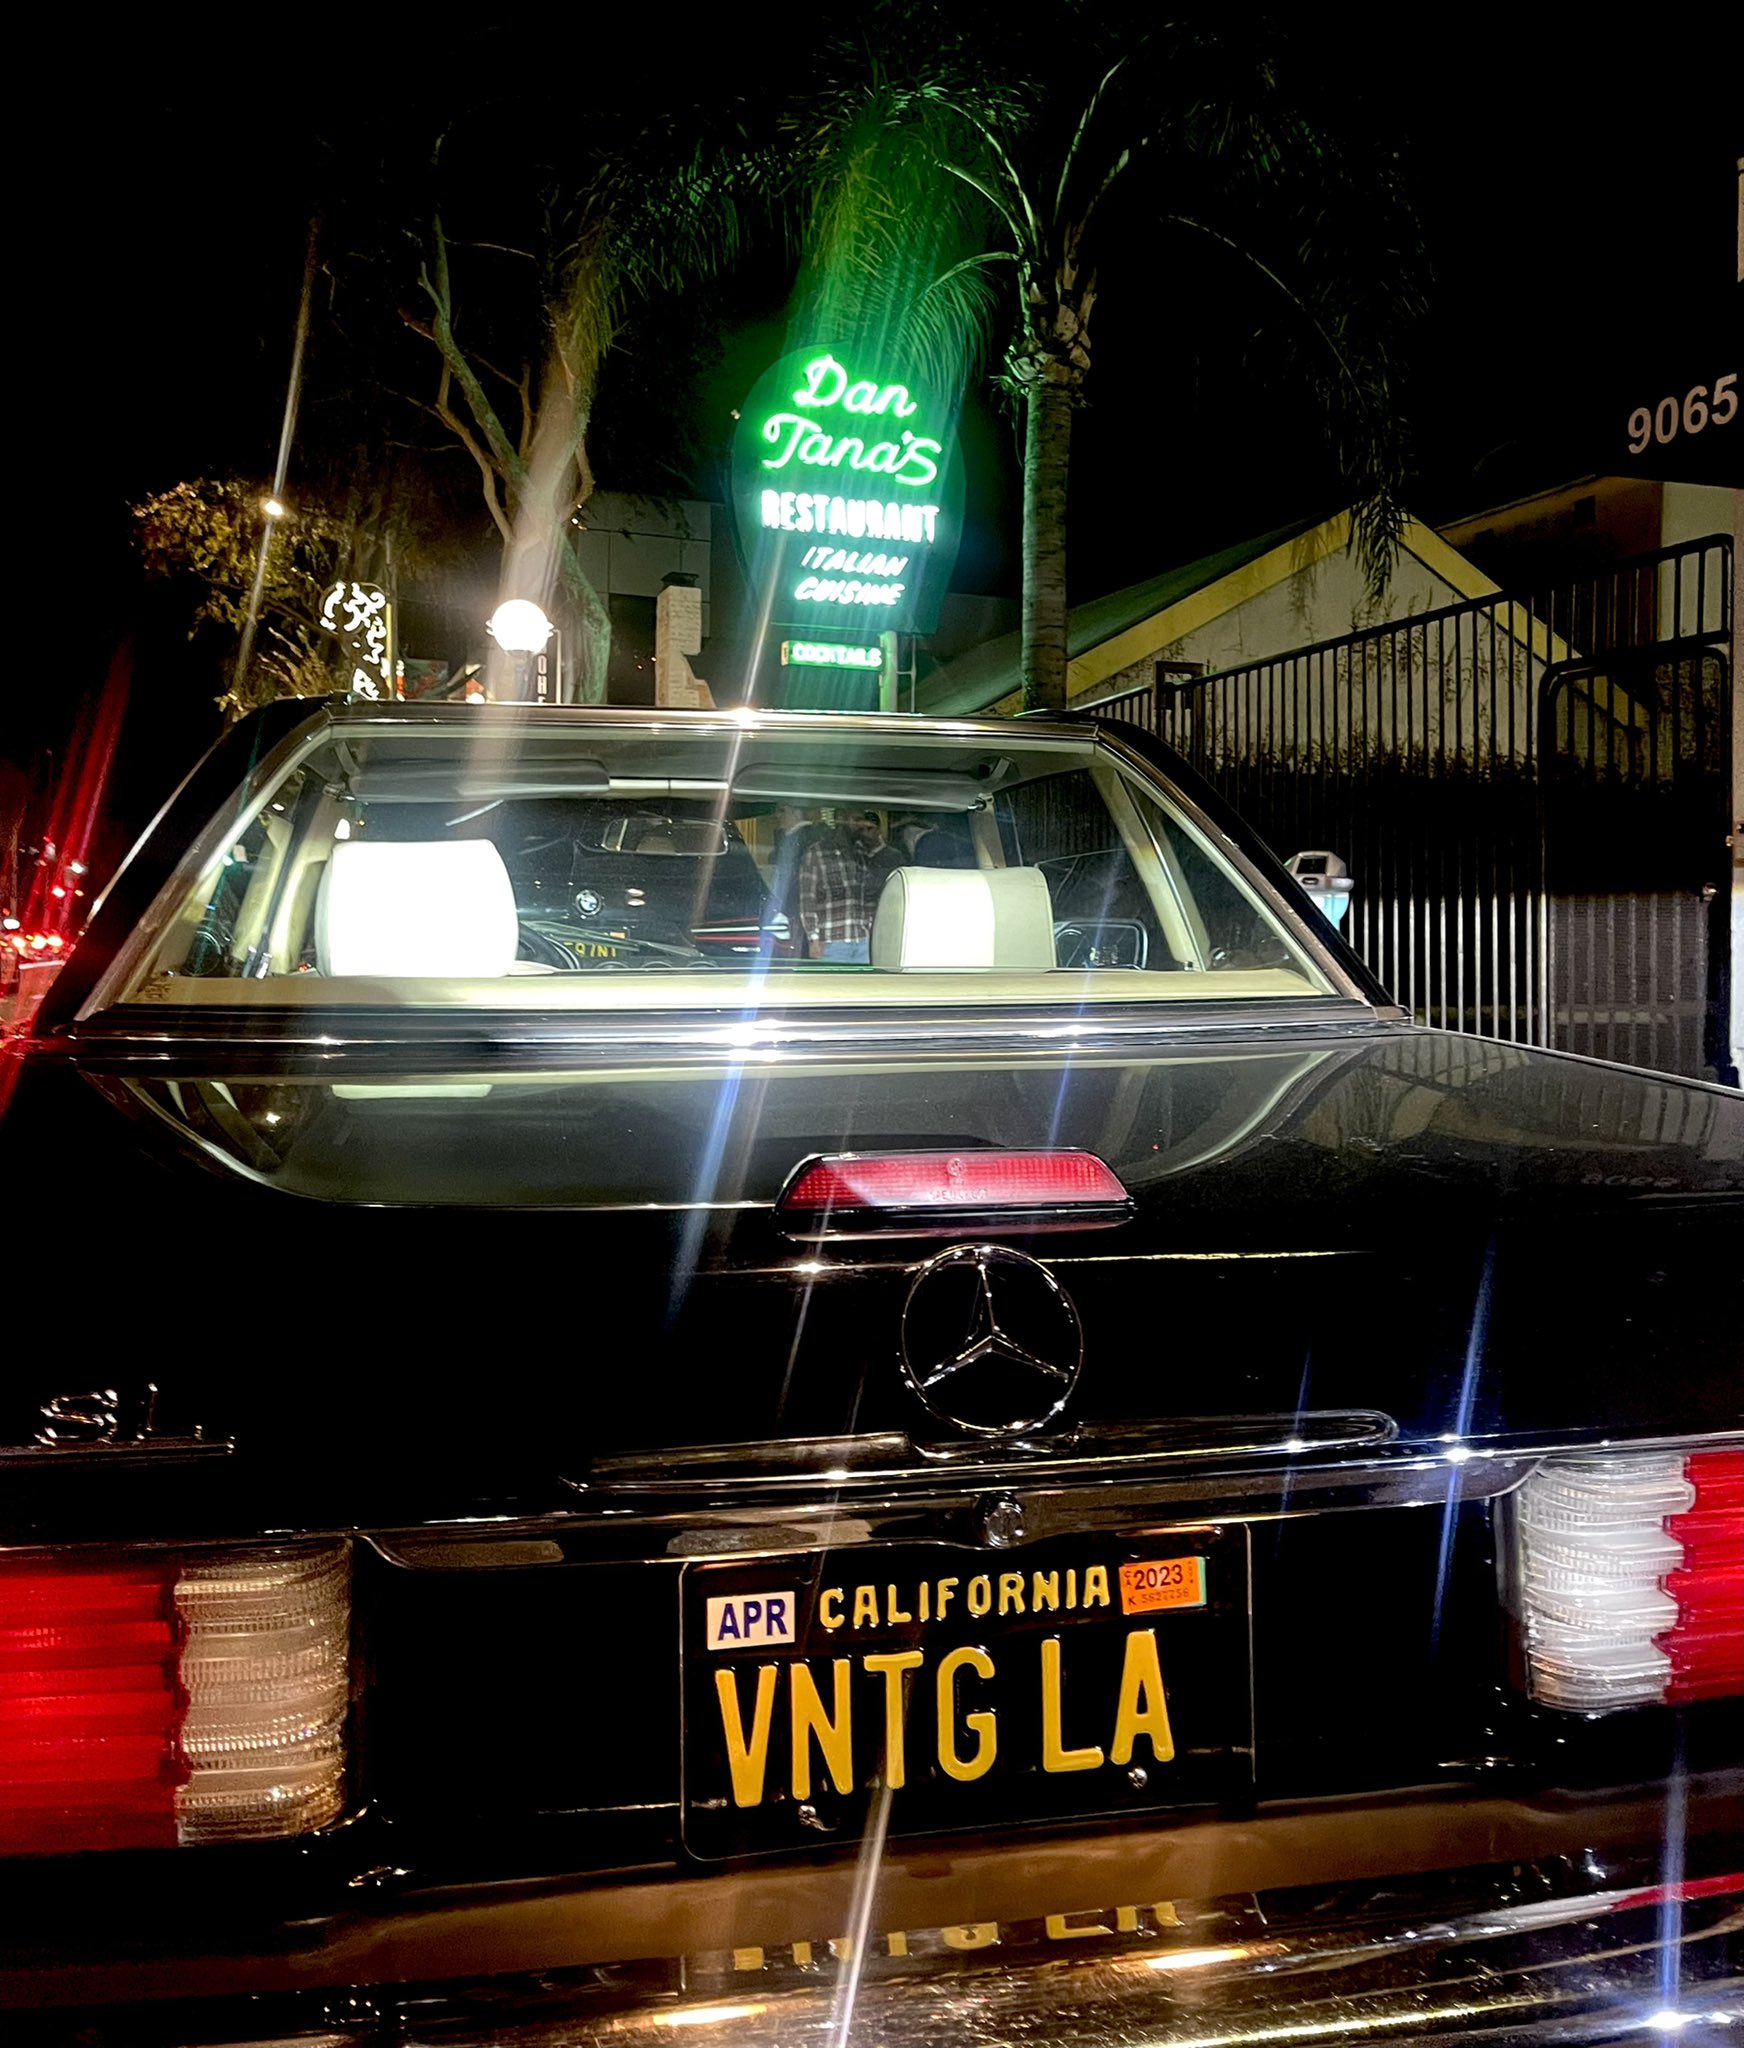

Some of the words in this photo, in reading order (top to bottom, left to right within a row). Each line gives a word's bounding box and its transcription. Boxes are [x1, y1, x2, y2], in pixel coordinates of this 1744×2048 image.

[793, 354, 918, 418] Dan
[1627, 372, 1739, 454] 9065
[761, 489, 940, 544] RESTAURANT
[801, 546, 909, 577] ITALIAN
[794, 576, 906, 606] CUISINE
[792, 643, 883, 667] COCKTAILS
[819, 1565, 1110, 1629] CALIFORNIA
[1133, 1564, 1184, 1591] 2023
[717, 1597, 788, 1641] APR
[715, 1646, 998, 1807] VNTG
[1041, 1629, 1175, 1773] LA
